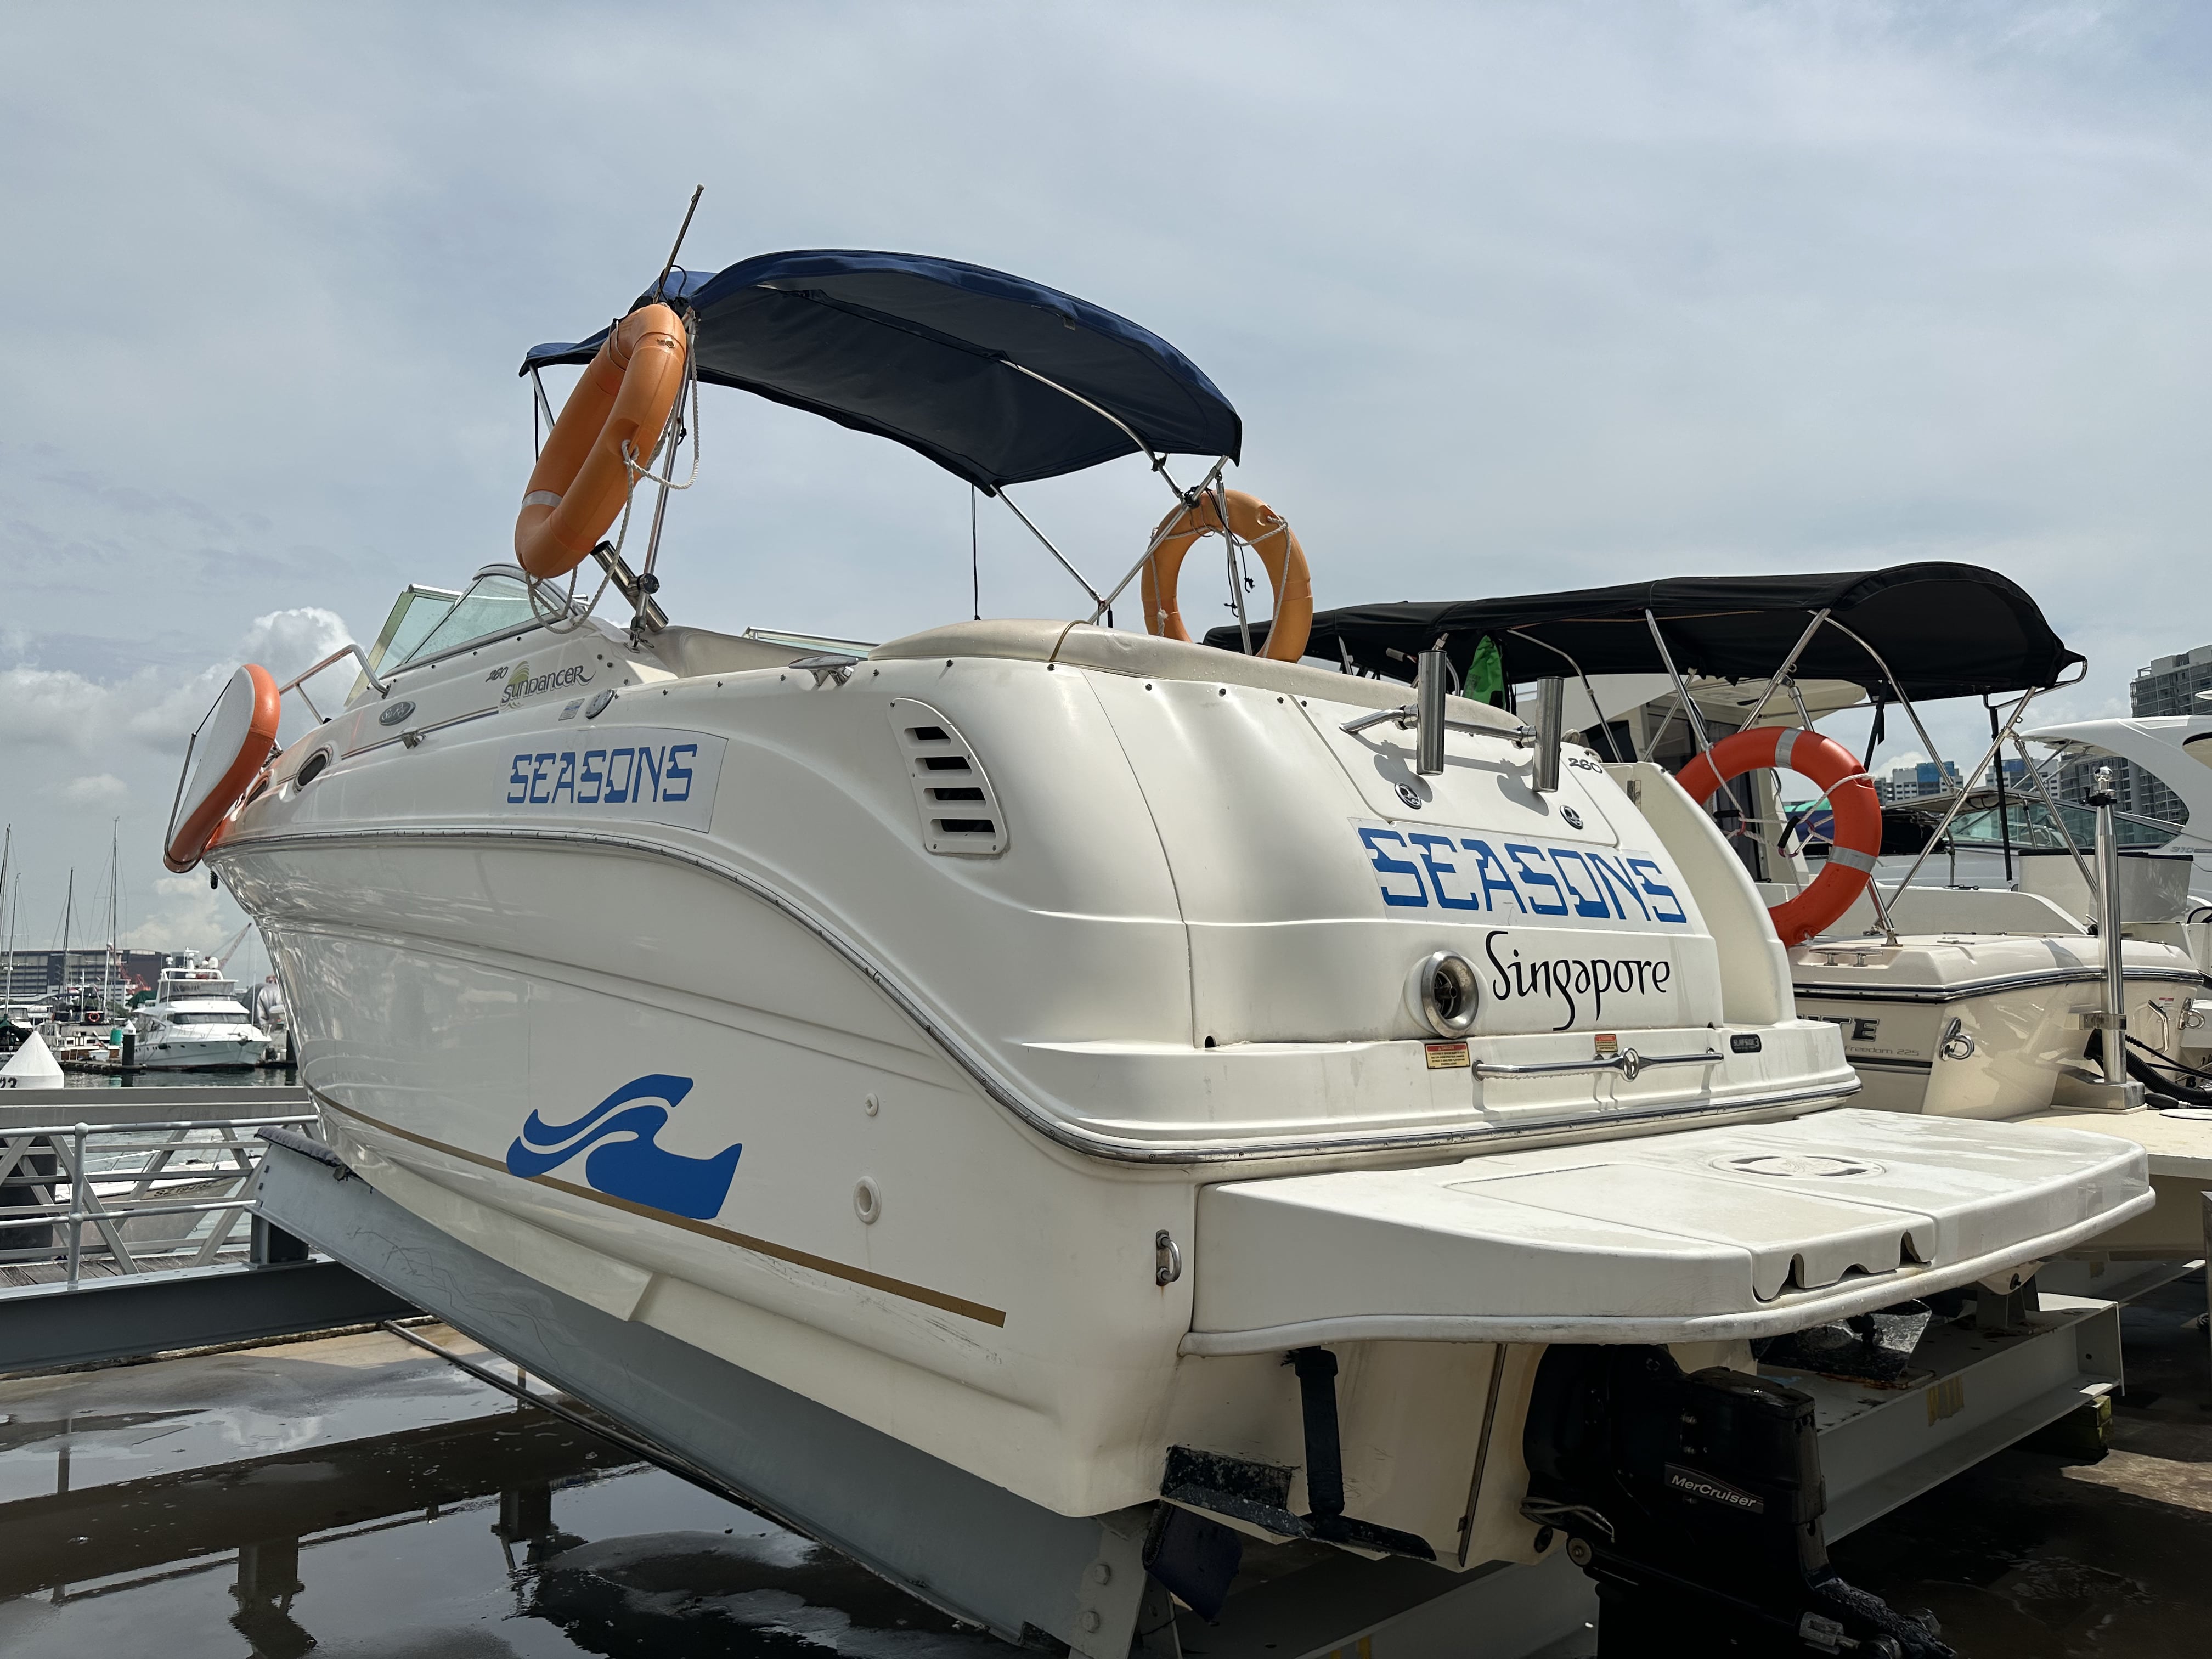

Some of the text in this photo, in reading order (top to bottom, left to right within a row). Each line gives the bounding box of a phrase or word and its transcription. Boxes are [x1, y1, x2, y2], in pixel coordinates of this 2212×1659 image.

[507, 744, 697, 803] SEASONS
[1359, 828, 1687, 923] SEASONS
[1485, 930, 1670, 1031] Singapore
[1844, 1045, 1893, 1054] Freedom
[1672, 1475, 1757, 1507] MerCruiser
